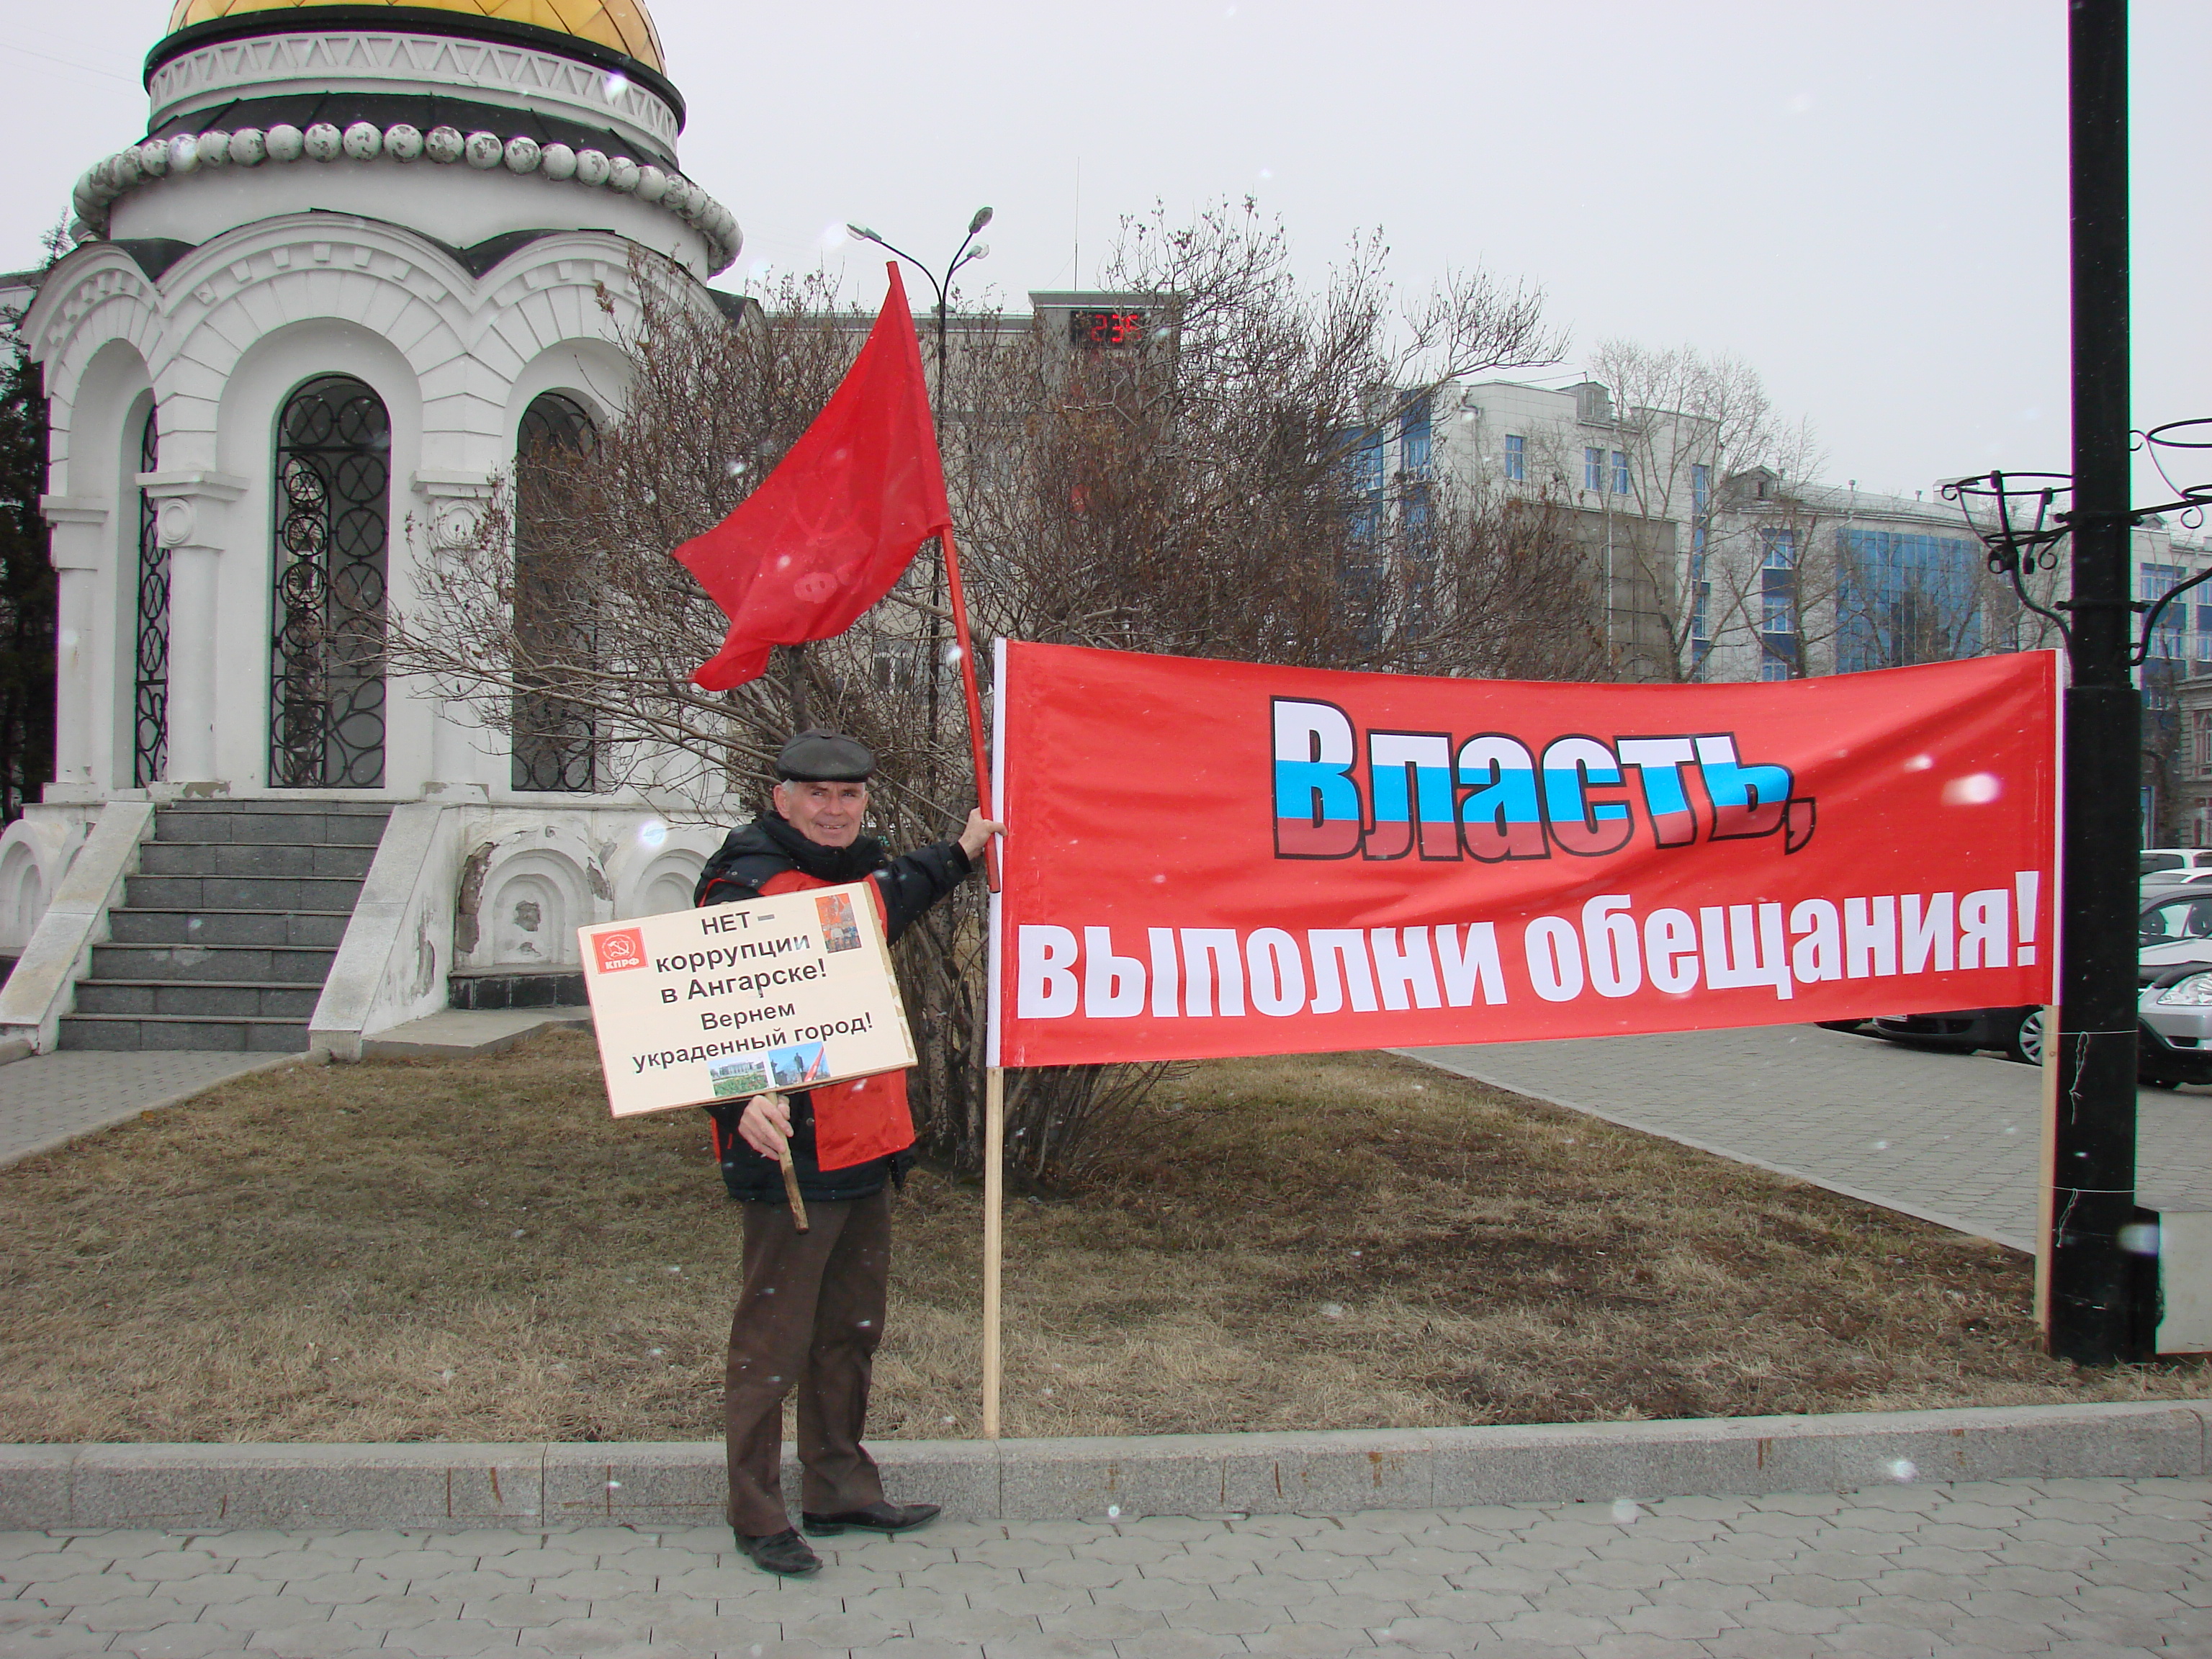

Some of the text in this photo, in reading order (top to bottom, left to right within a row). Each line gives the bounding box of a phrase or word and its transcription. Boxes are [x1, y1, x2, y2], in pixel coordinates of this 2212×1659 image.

[1272, 696, 1816, 863] Власть,
[701, 912, 751, 935] НЕТ
[1017, 870, 2040, 1018] выполни обещания!
[605, 958, 640, 970] КПРФ
[656, 934, 811, 973] коррупции
[661, 958, 827, 1004] в Ангарске!
[701, 1002, 796, 1031] Вернем
[632, 1012, 873, 1074] украденный город!
